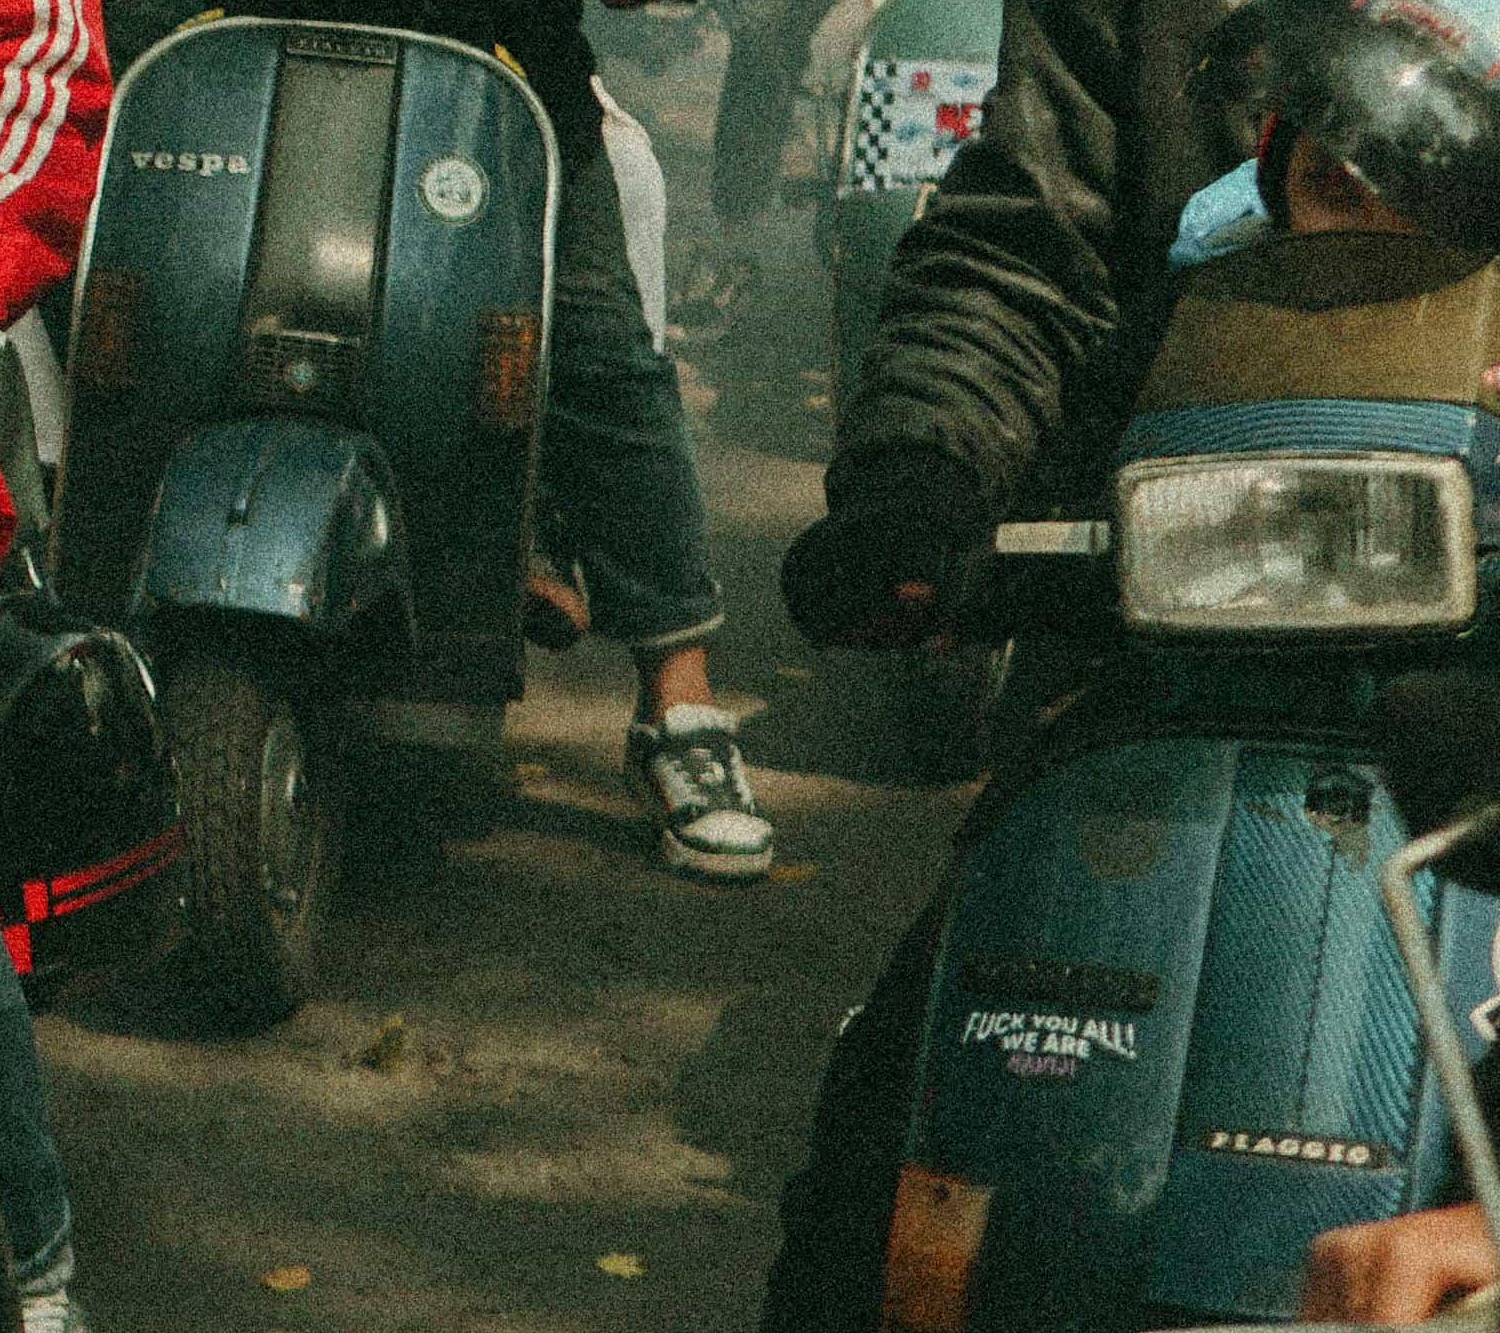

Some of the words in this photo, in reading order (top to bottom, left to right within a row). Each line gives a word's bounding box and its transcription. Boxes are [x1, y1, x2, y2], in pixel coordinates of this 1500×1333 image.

[131, 151, 252, 177] vespa
[961, 1011, 1026, 1044] FUCK
[1032, 1014, 1079, 1035] YOU
[1081, 1017, 1139, 1061] ALL!
[1001, 1032, 1039, 1053] WE
[1041, 1034, 1091, 1059] ARE
[1210, 1131, 1371, 1166] PIAGGIO
